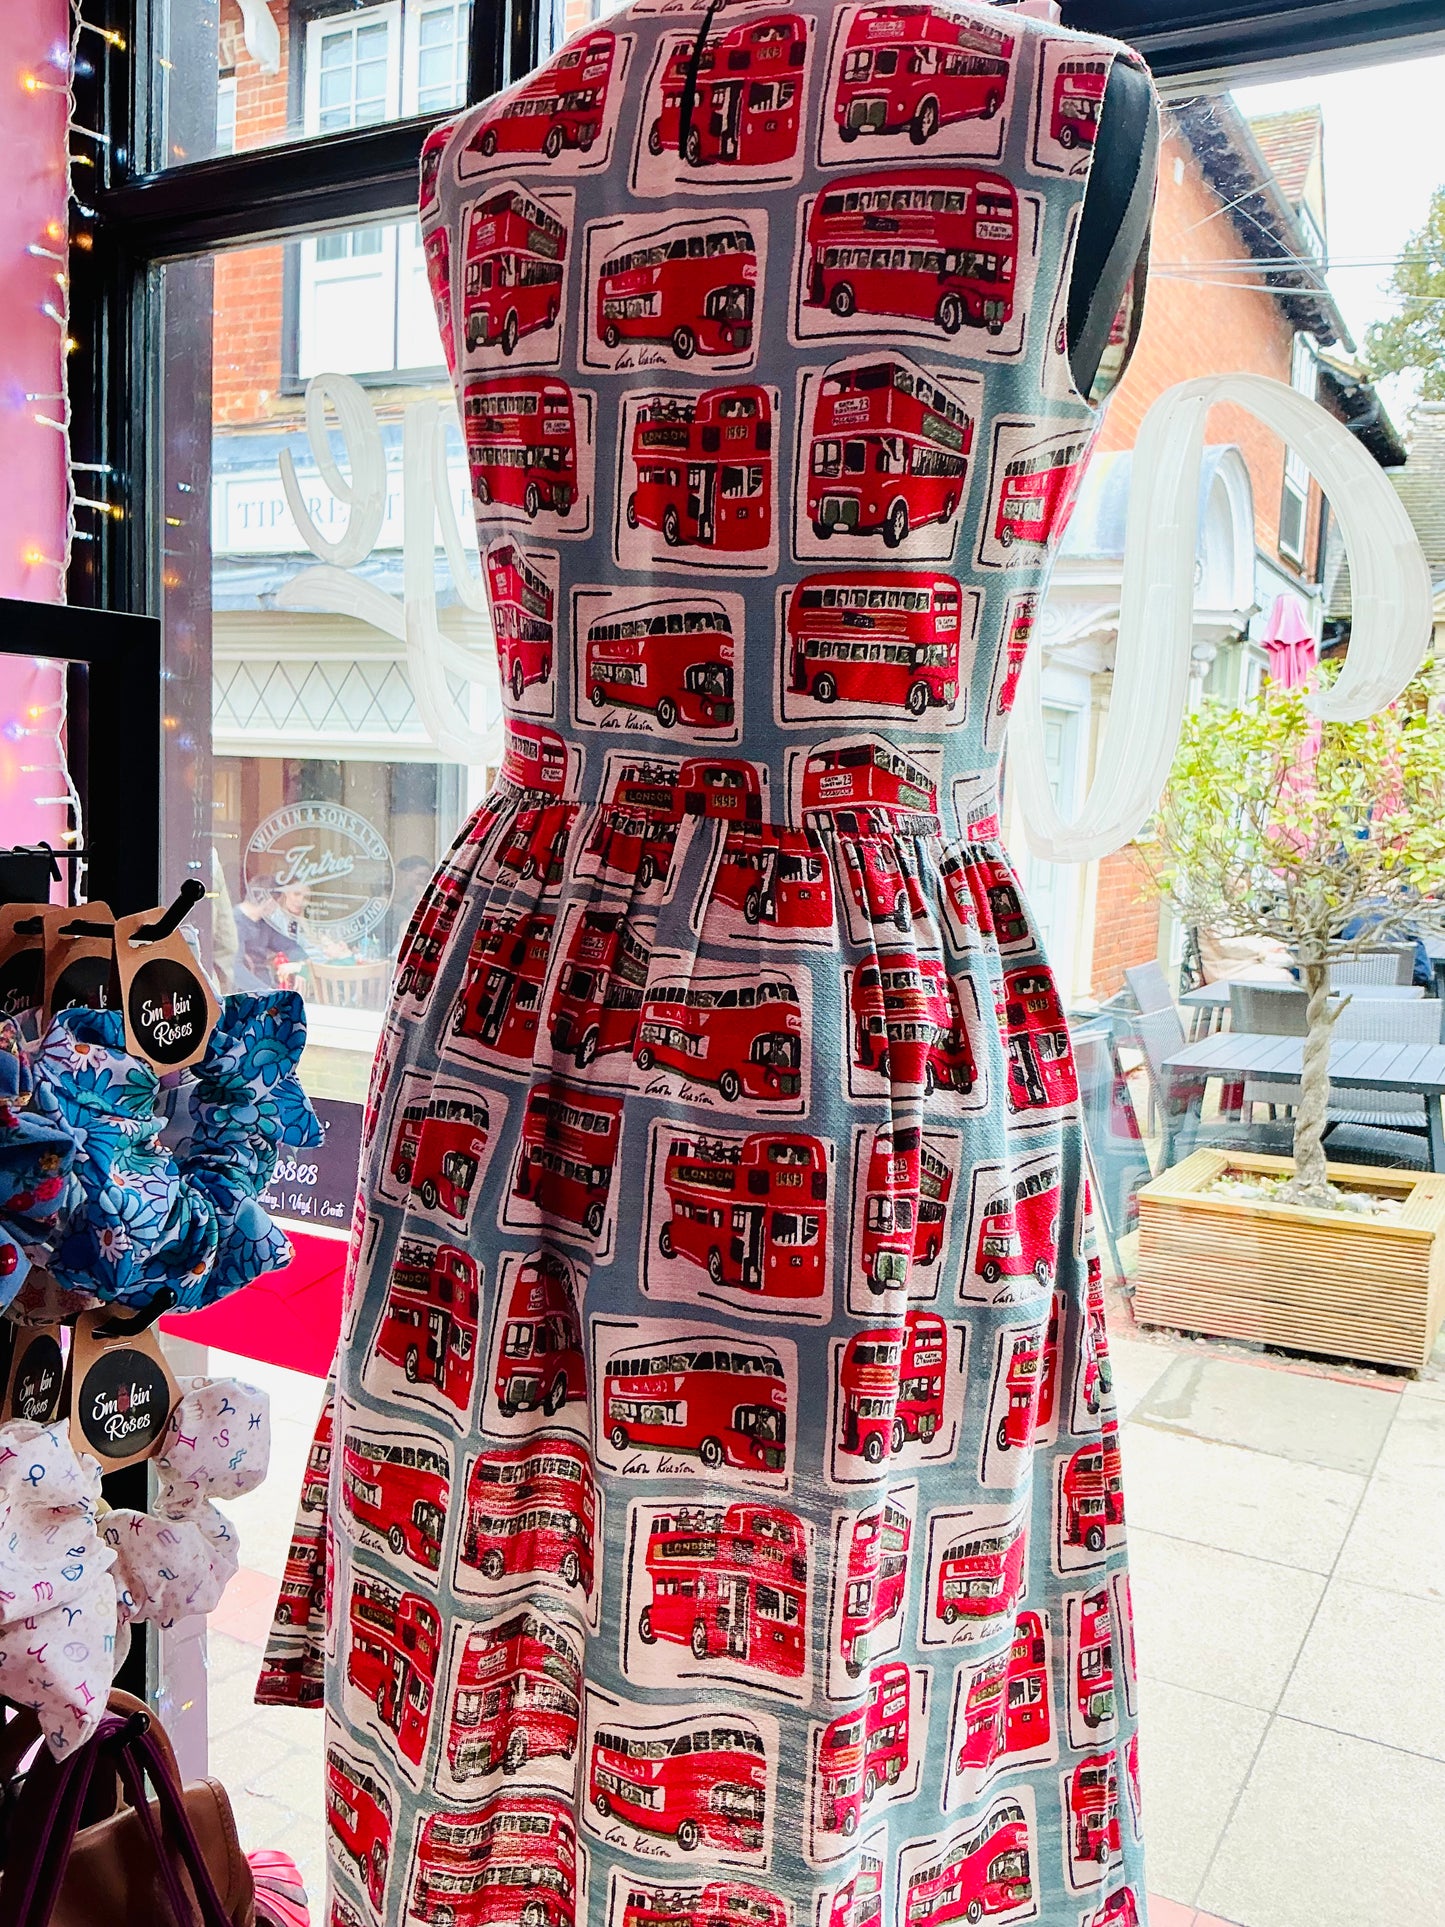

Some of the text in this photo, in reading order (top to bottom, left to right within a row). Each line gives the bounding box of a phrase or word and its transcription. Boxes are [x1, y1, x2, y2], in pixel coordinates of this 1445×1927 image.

[643, 431, 688, 444] LONDON
[237, 497, 352, 529] TIPRE
[629, 791, 672, 802] LONDON
[252, 808, 302, 850] WILKIN
[319, 807, 357, 832] SONS
[275, 845, 355, 886] Tiptree
[141, 992, 192, 1026] Smkin'
[153, 1021, 193, 1048] Roses
[270, 1160, 319, 1185] oses
[683, 1169, 733, 1181] LONDON
[392, 1271, 428, 1284] LONDON
[19, 1369, 55, 1401] Smkin'
[22, 1397, 49, 1420] Roses
[92, 1382, 153, 1420] Smkin'
[104, 1413, 151, 1441] Roses
